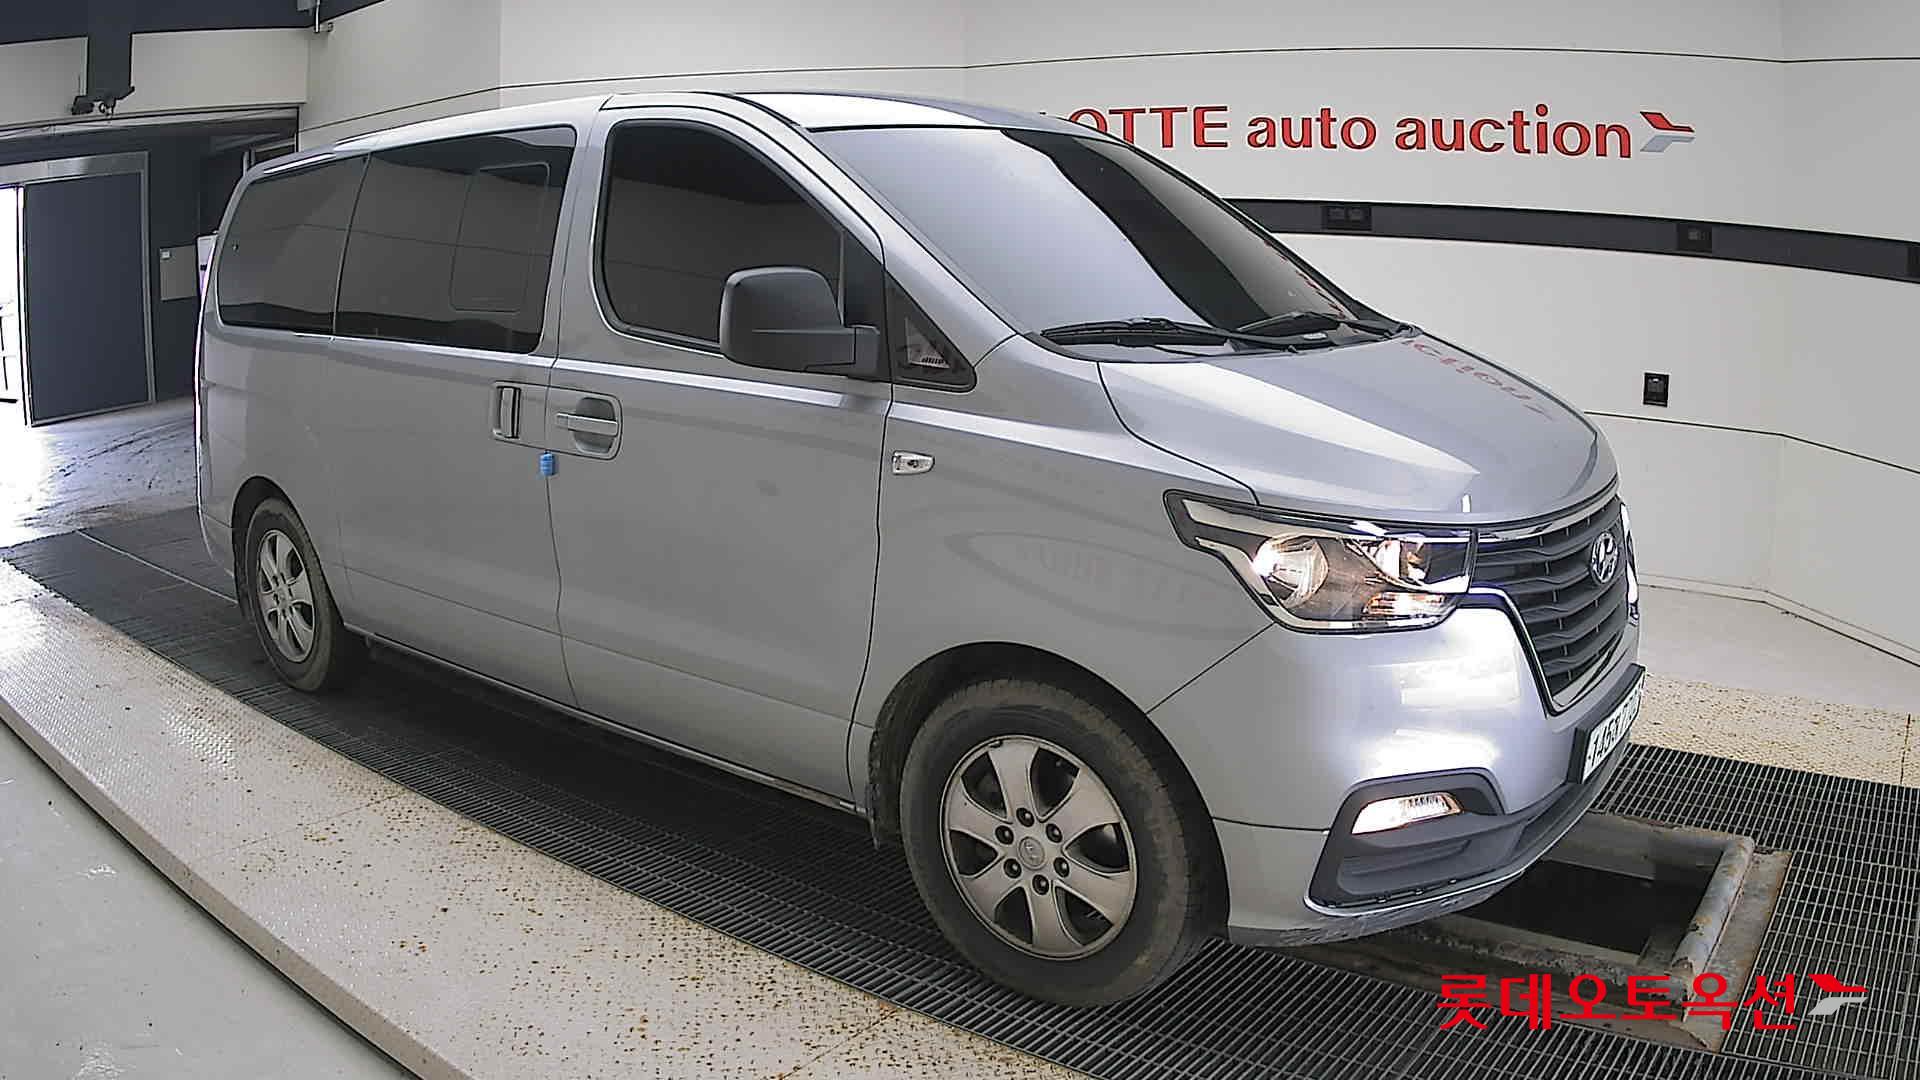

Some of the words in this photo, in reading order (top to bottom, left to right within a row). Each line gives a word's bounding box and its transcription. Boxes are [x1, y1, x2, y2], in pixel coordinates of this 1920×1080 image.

[1040, 106, 1228, 148] OTTE
[1247, 107, 1377, 149] auto
[1395, 103, 1631, 158] auction
